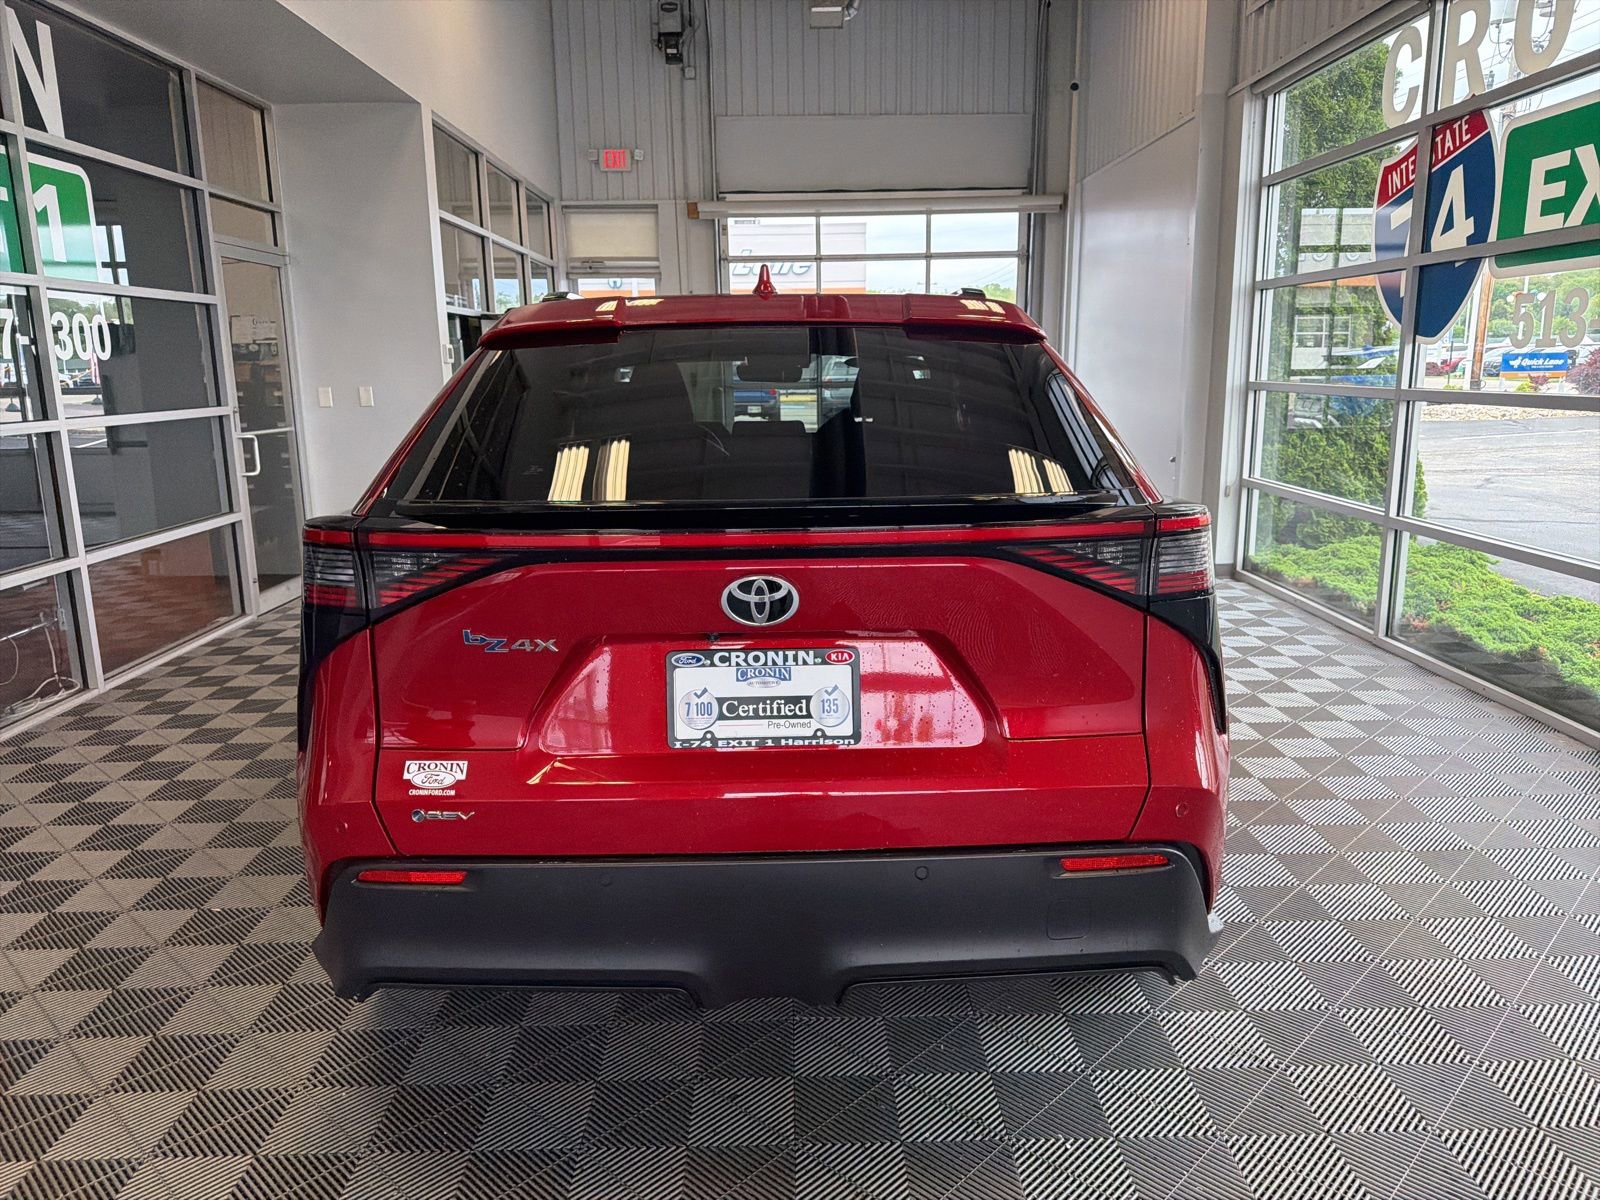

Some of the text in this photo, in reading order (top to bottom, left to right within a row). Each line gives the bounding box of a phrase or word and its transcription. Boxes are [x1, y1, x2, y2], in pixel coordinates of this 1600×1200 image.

[604, 149, 625, 168] EXIT
[1387, 114, 1472, 197] INTETATE
[1521, 357, 1564, 366] Quick Lane
[679, 650, 850, 667] Ford CRONIN KIA
[737, 667, 790, 681] CRONIN
[722, 699, 808, 717] Certified
[820, 698, 838, 714] 135
[767, 720, 812, 729] Pre-Owned
[673, 740, 712, 748] I-74
[718, 739, 760, 747] EXIT
[781, 737, 854, 746] Harrison
[406, 762, 466, 776] CRONIN
[421, 773, 446, 785] Ford
